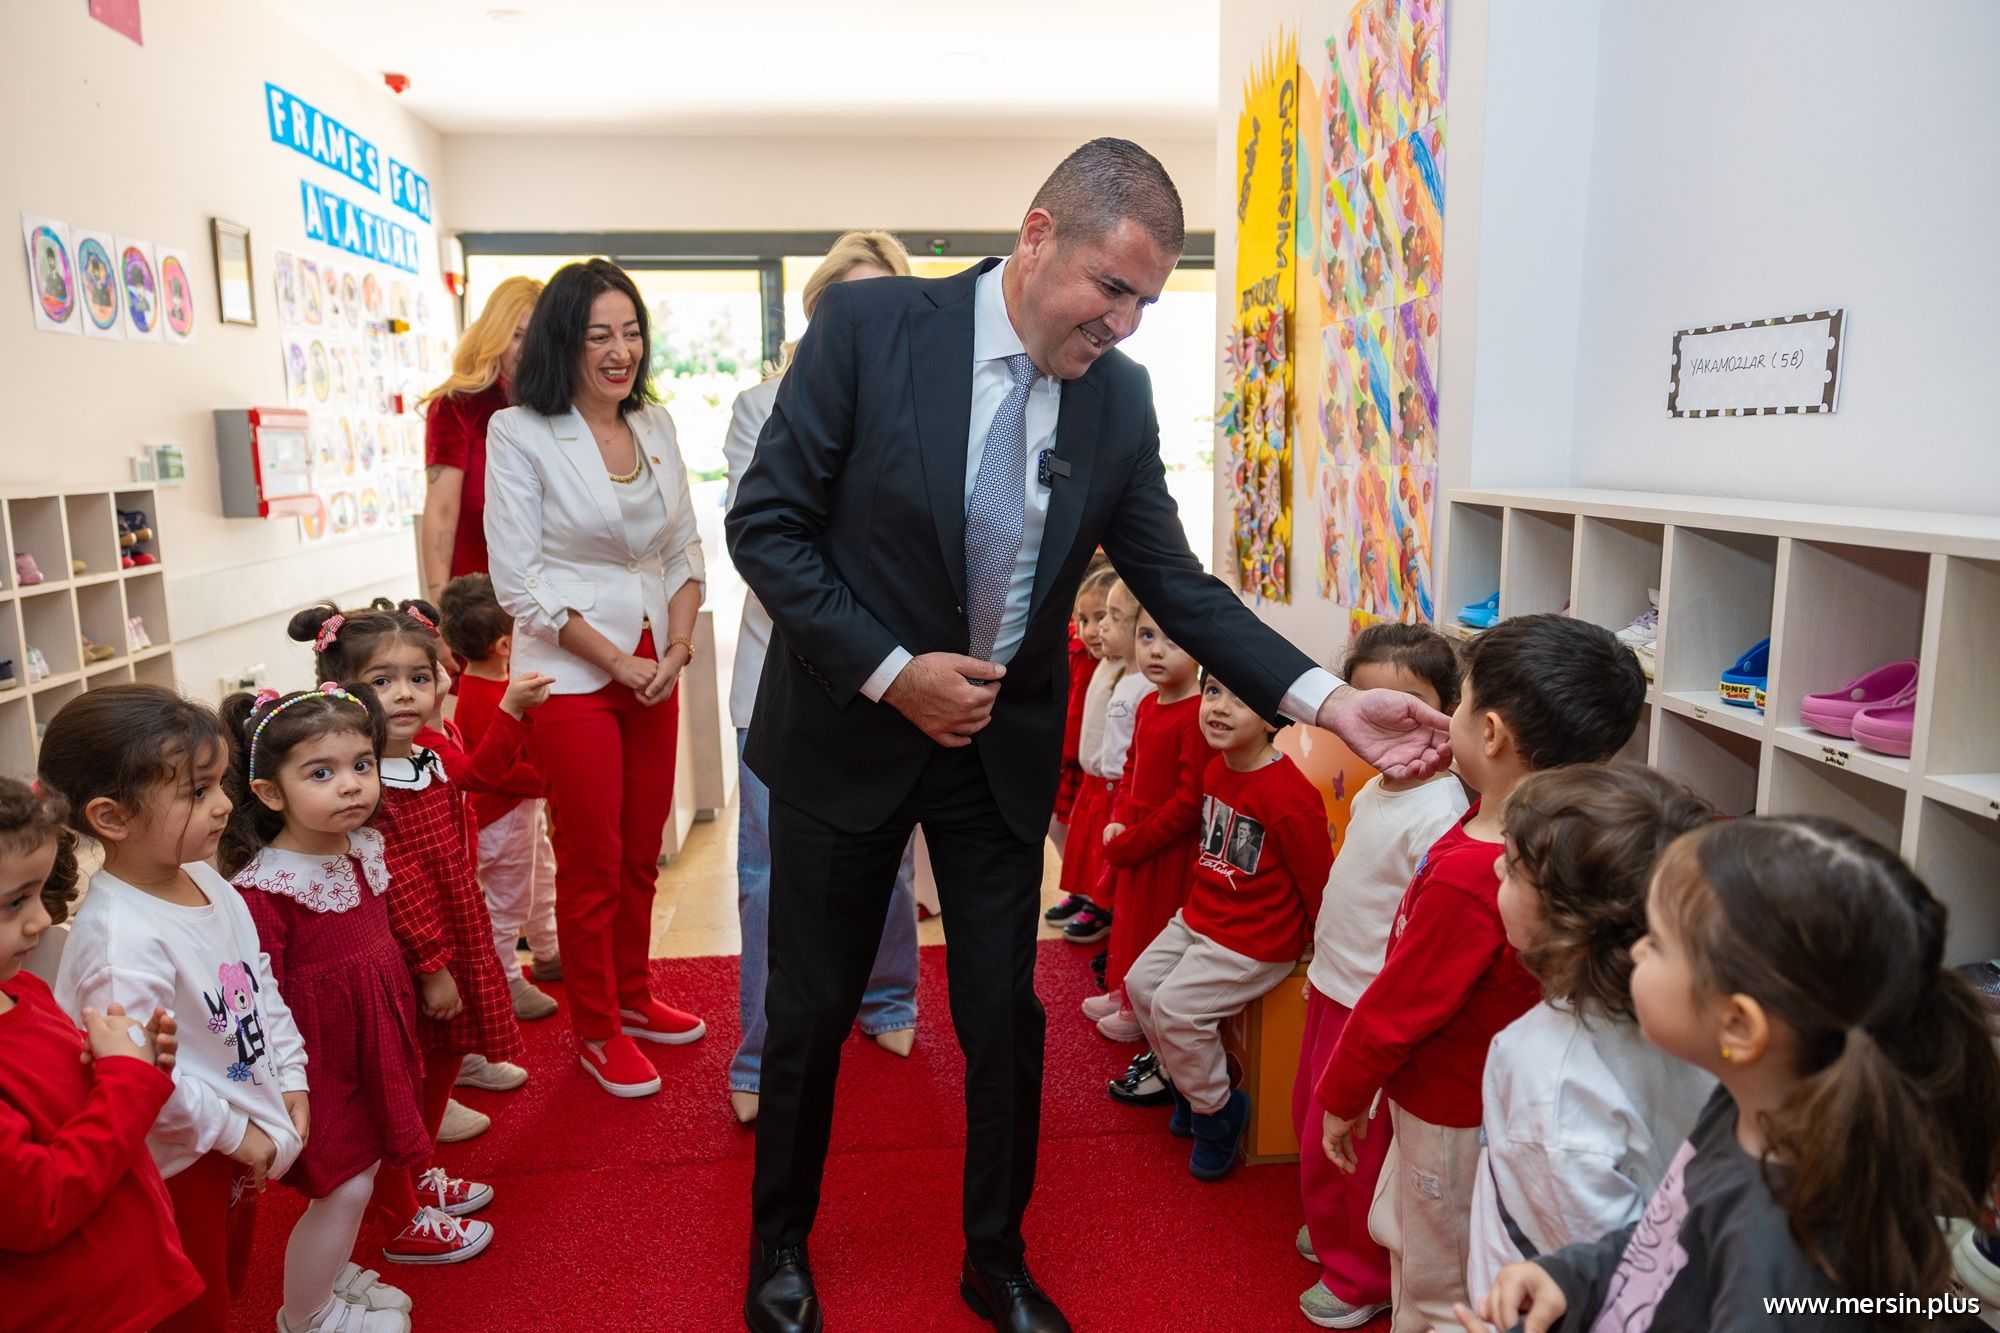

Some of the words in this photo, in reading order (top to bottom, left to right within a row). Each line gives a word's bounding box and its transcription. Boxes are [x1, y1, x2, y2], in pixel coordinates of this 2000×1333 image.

[270, 88, 379, 189] FRAMES
[391, 163, 430, 219] FOR
[1720, 683, 1751, 694] SONIC
